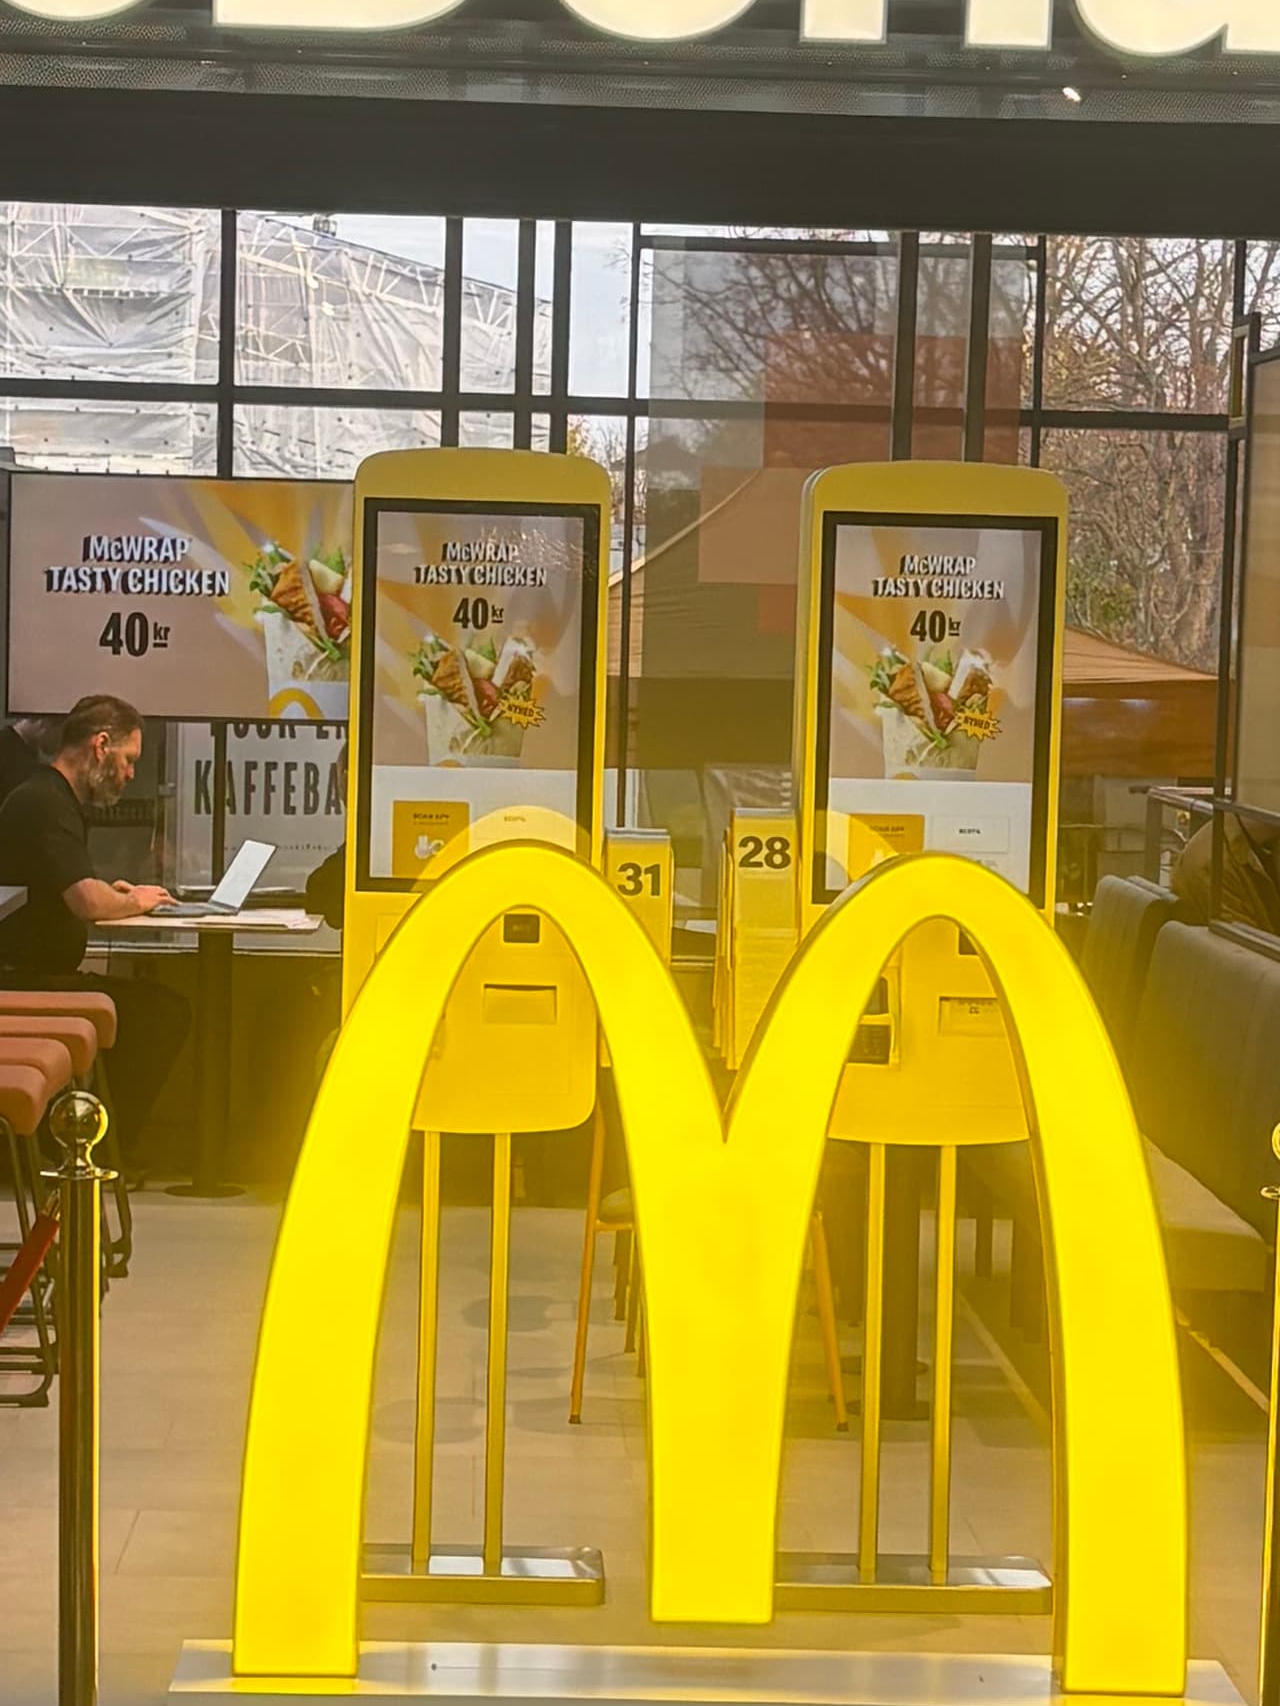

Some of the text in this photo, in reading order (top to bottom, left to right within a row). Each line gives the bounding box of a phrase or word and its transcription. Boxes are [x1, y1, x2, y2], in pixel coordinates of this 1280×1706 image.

[83, 535, 190, 562] McWRAP
[442, 542, 520, 563] McWRAP
[415, 565, 548, 587] TASTY CHICKEN
[900, 555, 977, 576] McWRAP
[45, 566, 230, 596] TASTY CHICKEN
[872, 577, 1005, 600] TASTY CHICKEN
[453, 597, 489, 630] 40
[910, 610, 946, 643] 40
[99, 612, 150, 656] 40
[738, 835, 792, 870] 28
[617, 861, 662, 897] 31
